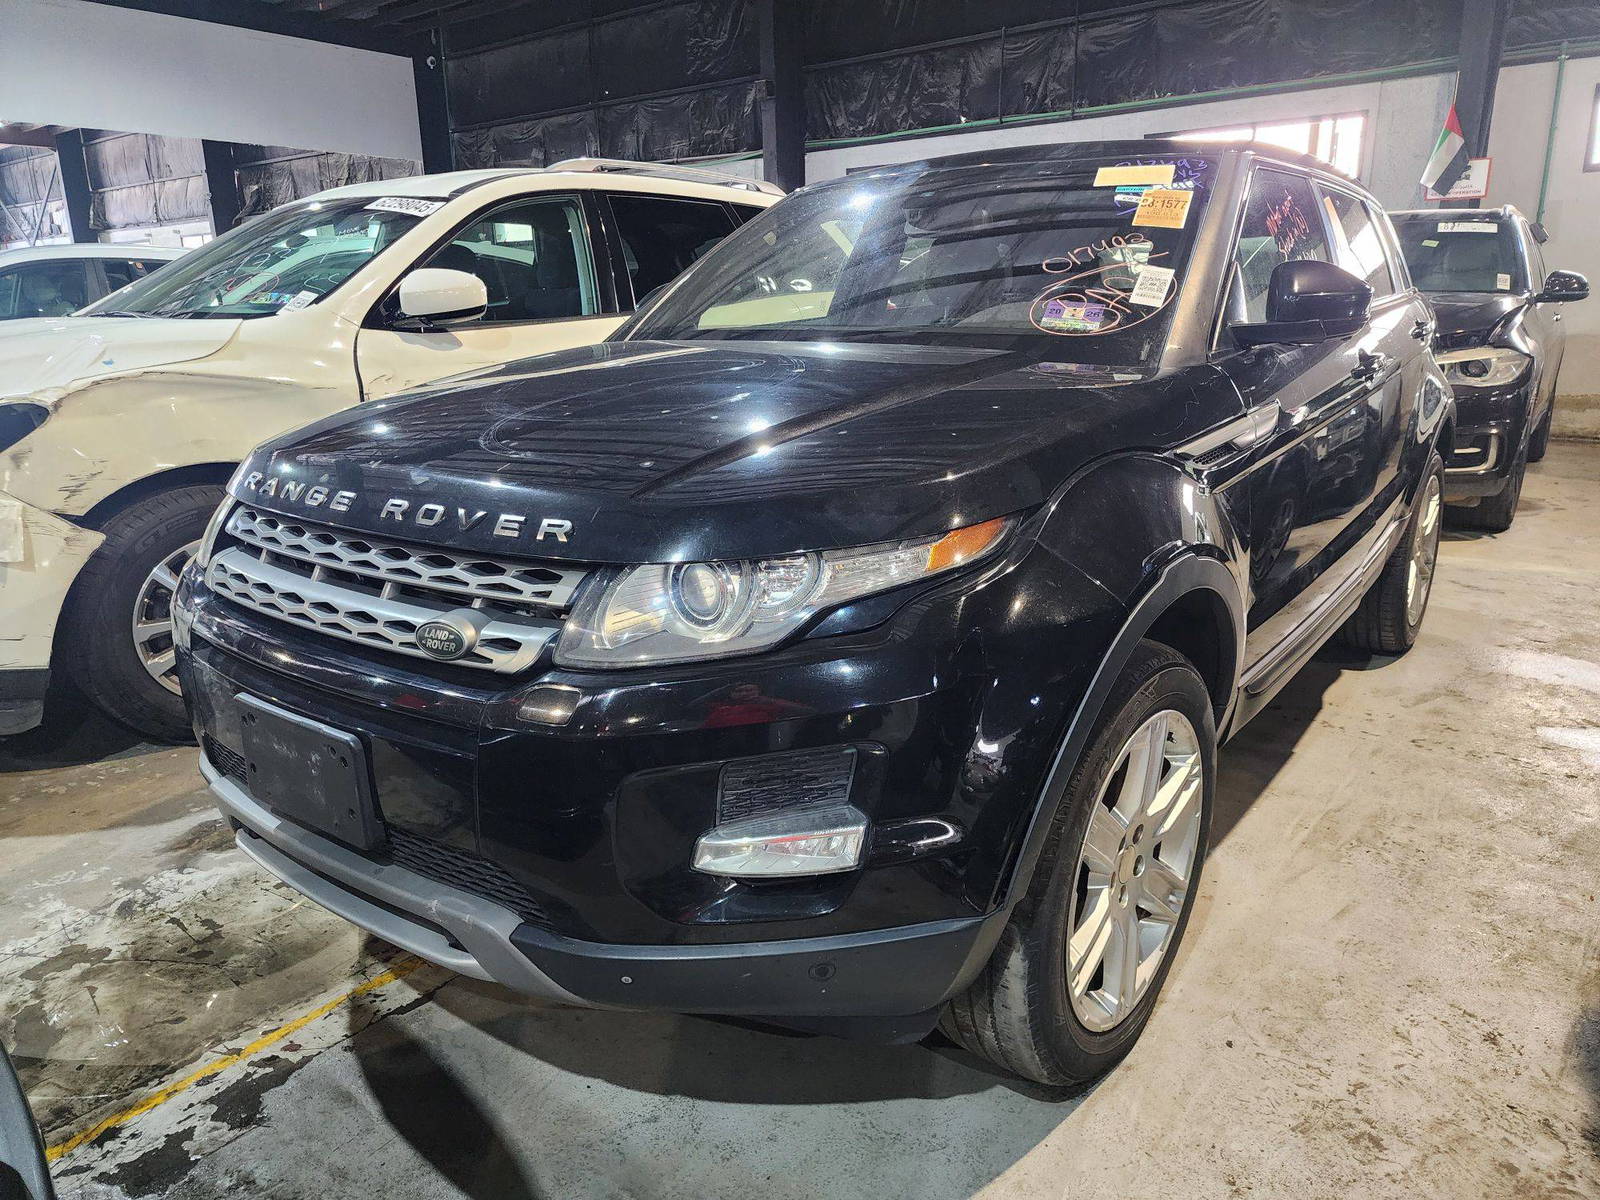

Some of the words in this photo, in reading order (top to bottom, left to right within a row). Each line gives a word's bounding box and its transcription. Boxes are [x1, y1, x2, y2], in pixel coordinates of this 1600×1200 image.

[243, 471, 358, 512] RANGE
[380, 498, 575, 543] ROVER
[426, 638, 457, 653] ROVER
